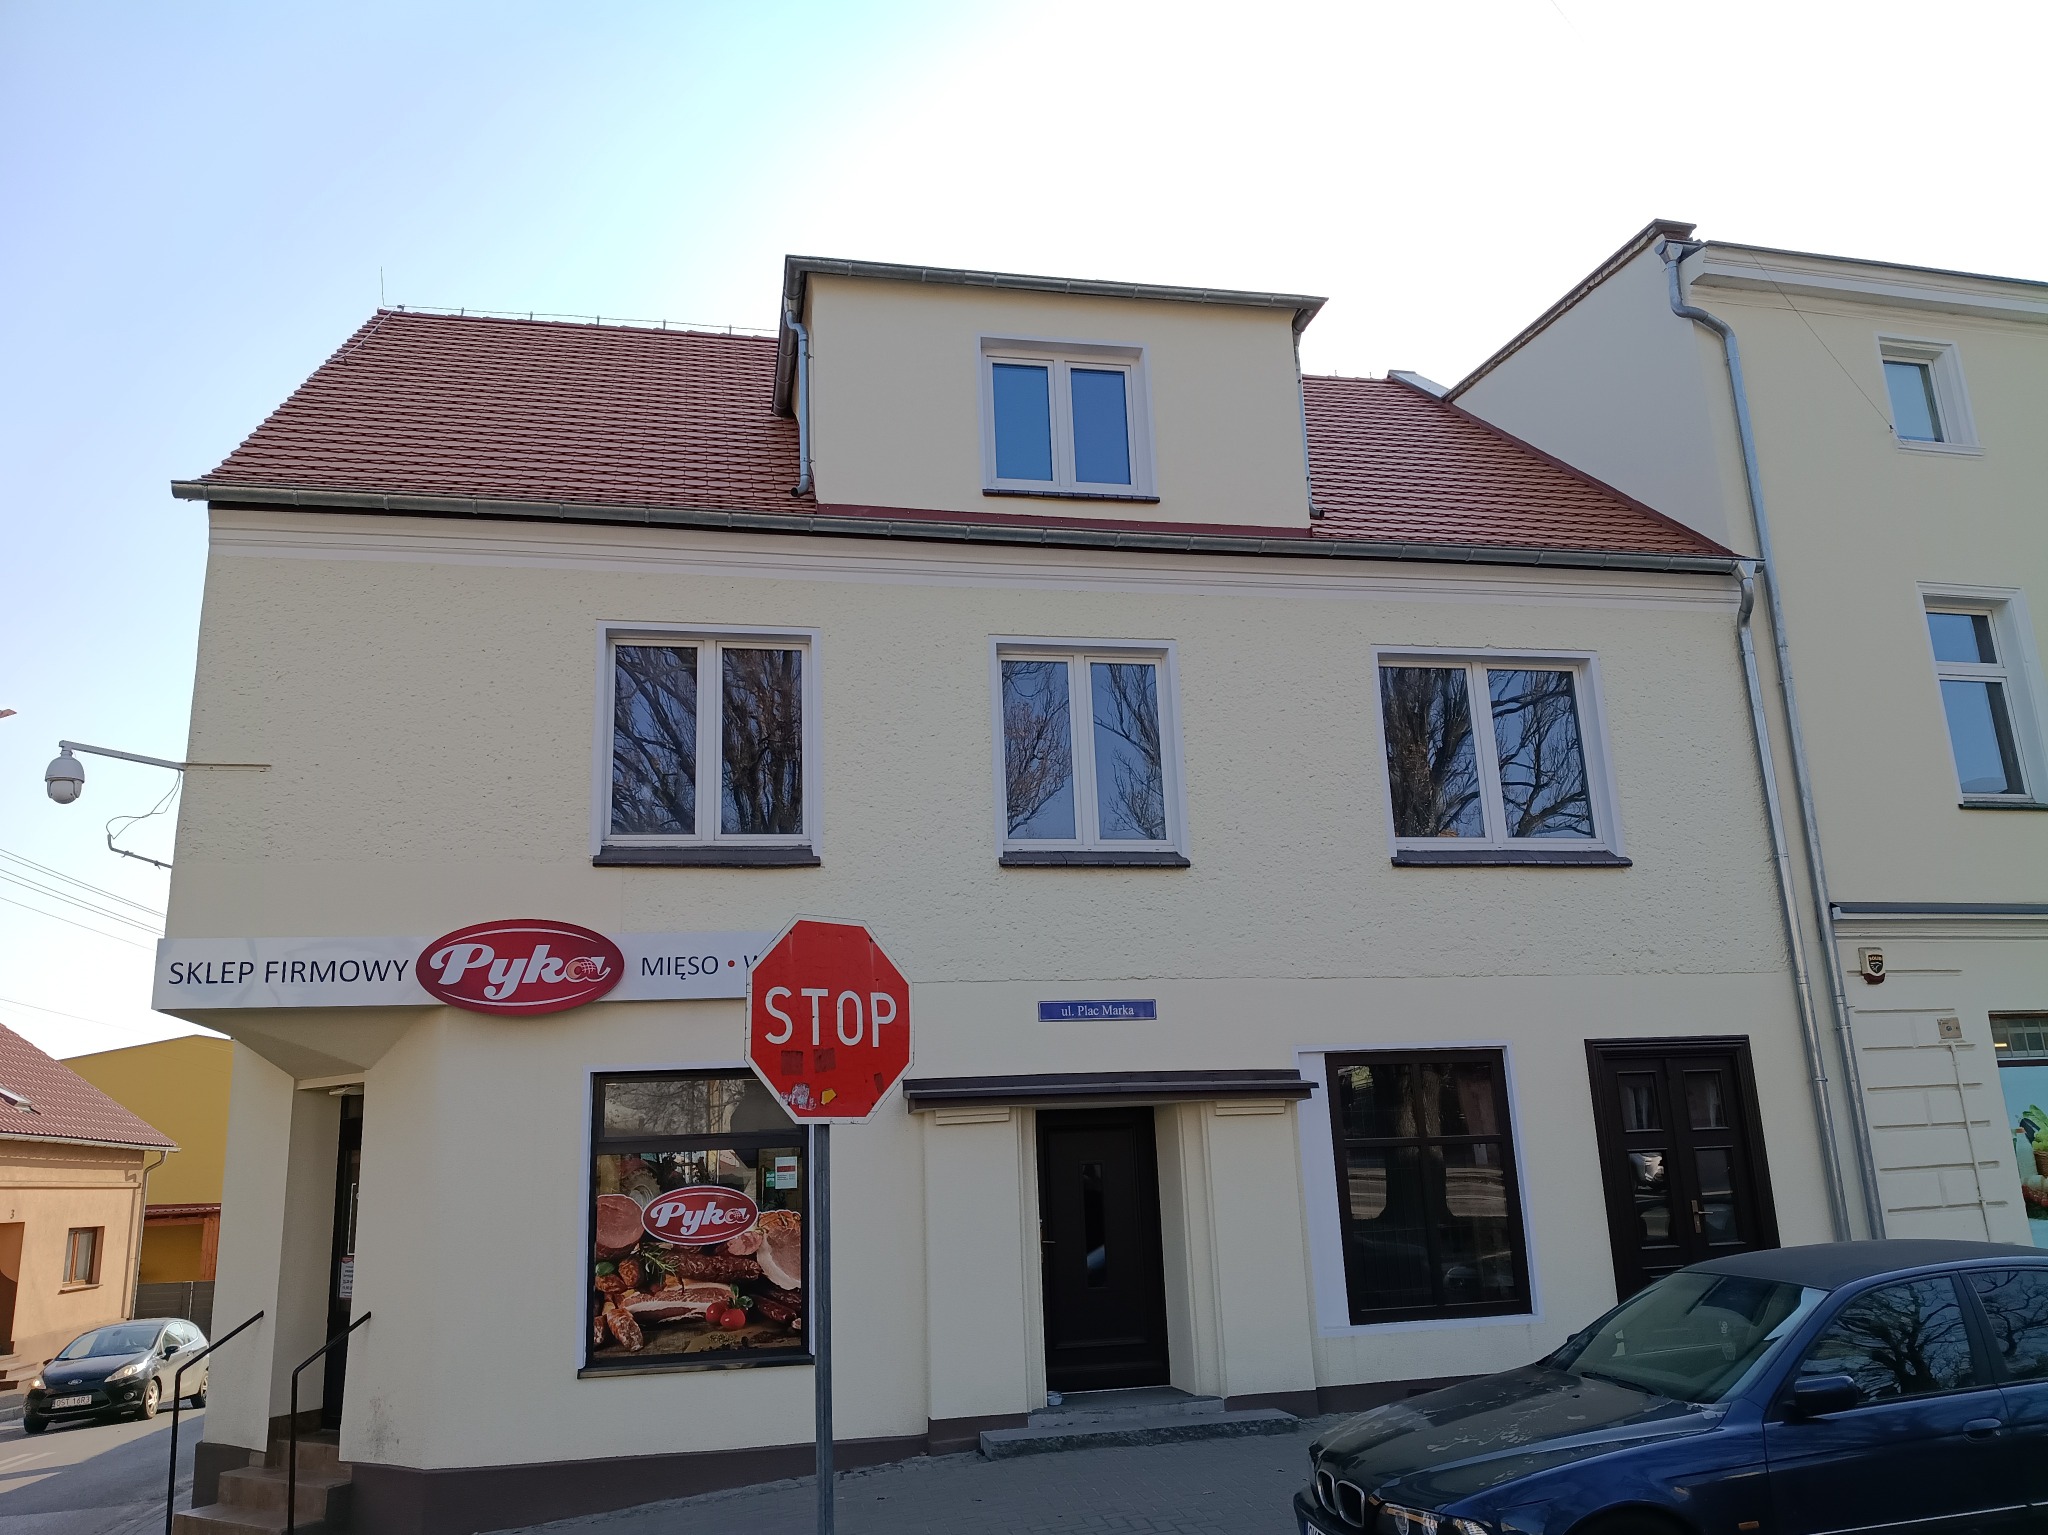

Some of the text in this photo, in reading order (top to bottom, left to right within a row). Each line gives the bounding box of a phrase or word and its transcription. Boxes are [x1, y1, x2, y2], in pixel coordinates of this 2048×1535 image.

[168, 959, 409, 984] SKLEP FIRMOWY
[429, 943, 611, 1000] Pyka
[641, 956, 719, 980] MIĘSO
[764, 986, 897, 1048] STOP
[1061, 1004, 1134, 1016] ul. Plac Marka
[10, 1209, 15, 1219] 3
[650, 1201, 750, 1235] Pyka
